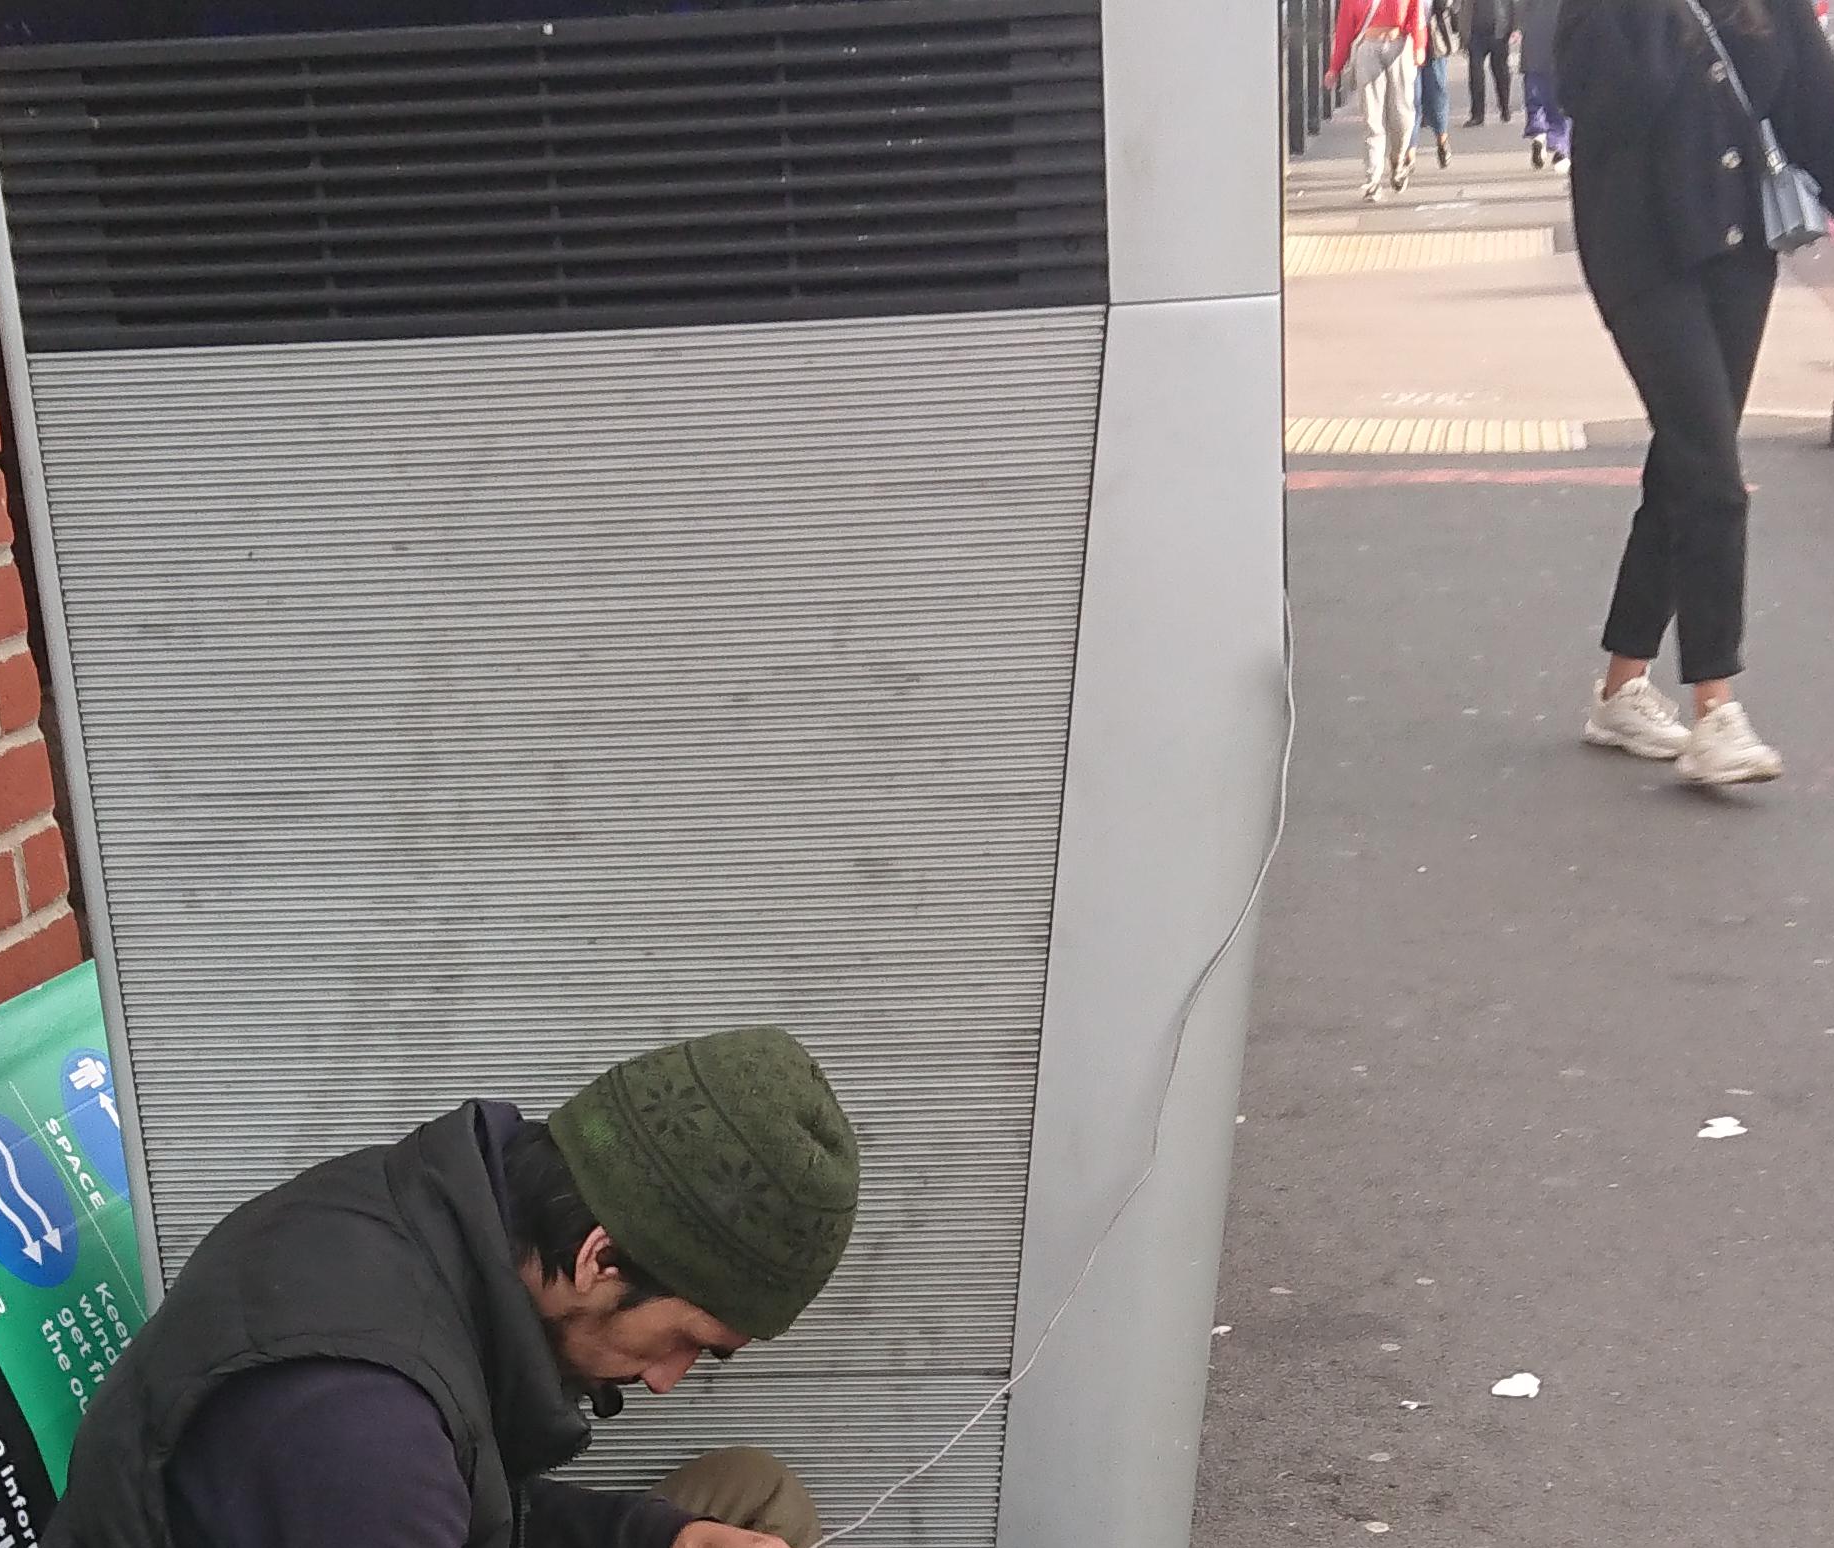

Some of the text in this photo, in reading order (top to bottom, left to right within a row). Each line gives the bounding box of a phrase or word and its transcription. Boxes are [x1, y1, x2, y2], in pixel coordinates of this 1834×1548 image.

[45, 1117, 106, 1211] SPACE
[41, 1318, 72, 1372] the
[56, 1307, 92, 1359] get
